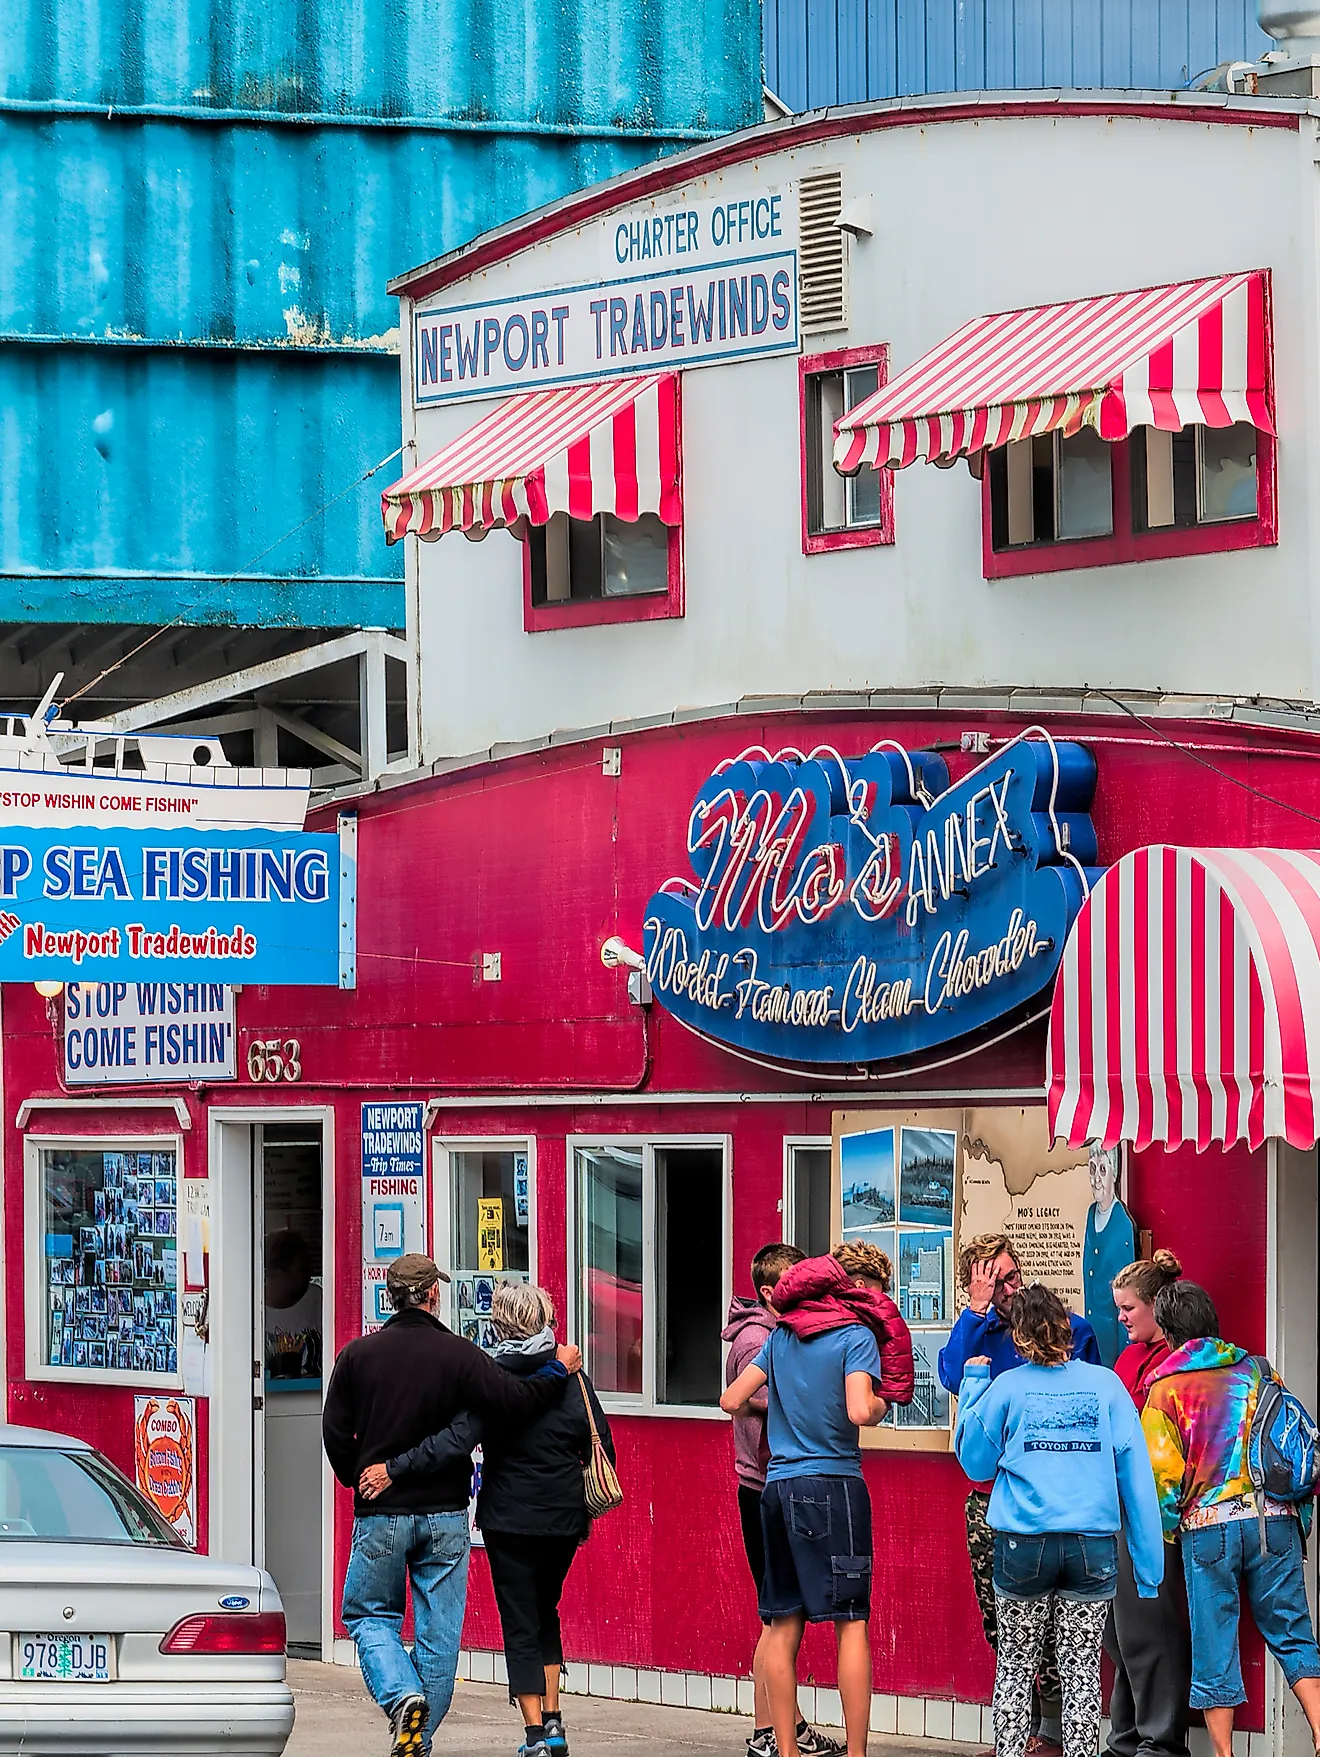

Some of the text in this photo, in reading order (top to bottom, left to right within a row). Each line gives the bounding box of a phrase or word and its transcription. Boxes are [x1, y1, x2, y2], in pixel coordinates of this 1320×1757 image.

[615, 194, 783, 264] CHARTER OFFICE
[420, 269, 791, 387] NEWPORT TRADEWINDS
[44, 793, 96, 810] WISHIN
[99, 795, 142, 812] COME
[145, 797, 199, 814] FISHIN"
[687, 769, 1014, 935] Mo's ANNEX
[42, 845, 134, 900] SEA
[142, 847, 329, 903] FISHING
[0, 912, 21, 944] ith
[25, 922, 256, 964] Newport Tradewinds
[643, 908, 1050, 1032] World Famous Clam Chowder
[67, 982, 127, 1019] STOP
[66, 1022, 232, 1069] COME FISHIN'
[247, 1038, 302, 1082] 653
[367, 1107, 418, 1130] NEWPORT
[363, 1132, 421, 1154] TRADEWINDS
[370, 1179, 417, 1195] FISHING
[1017, 1207, 1061, 1218] MO'S LEGACY
[379, 1223, 394, 1242] 7am
[151, 1419, 177, 1433] COMBO
[1031, 1442, 1094, 1451] TOYON BAY
[47, 1633, 81, 1643] Oregon
[24, 1643, 106, 1669] 978 DJB
